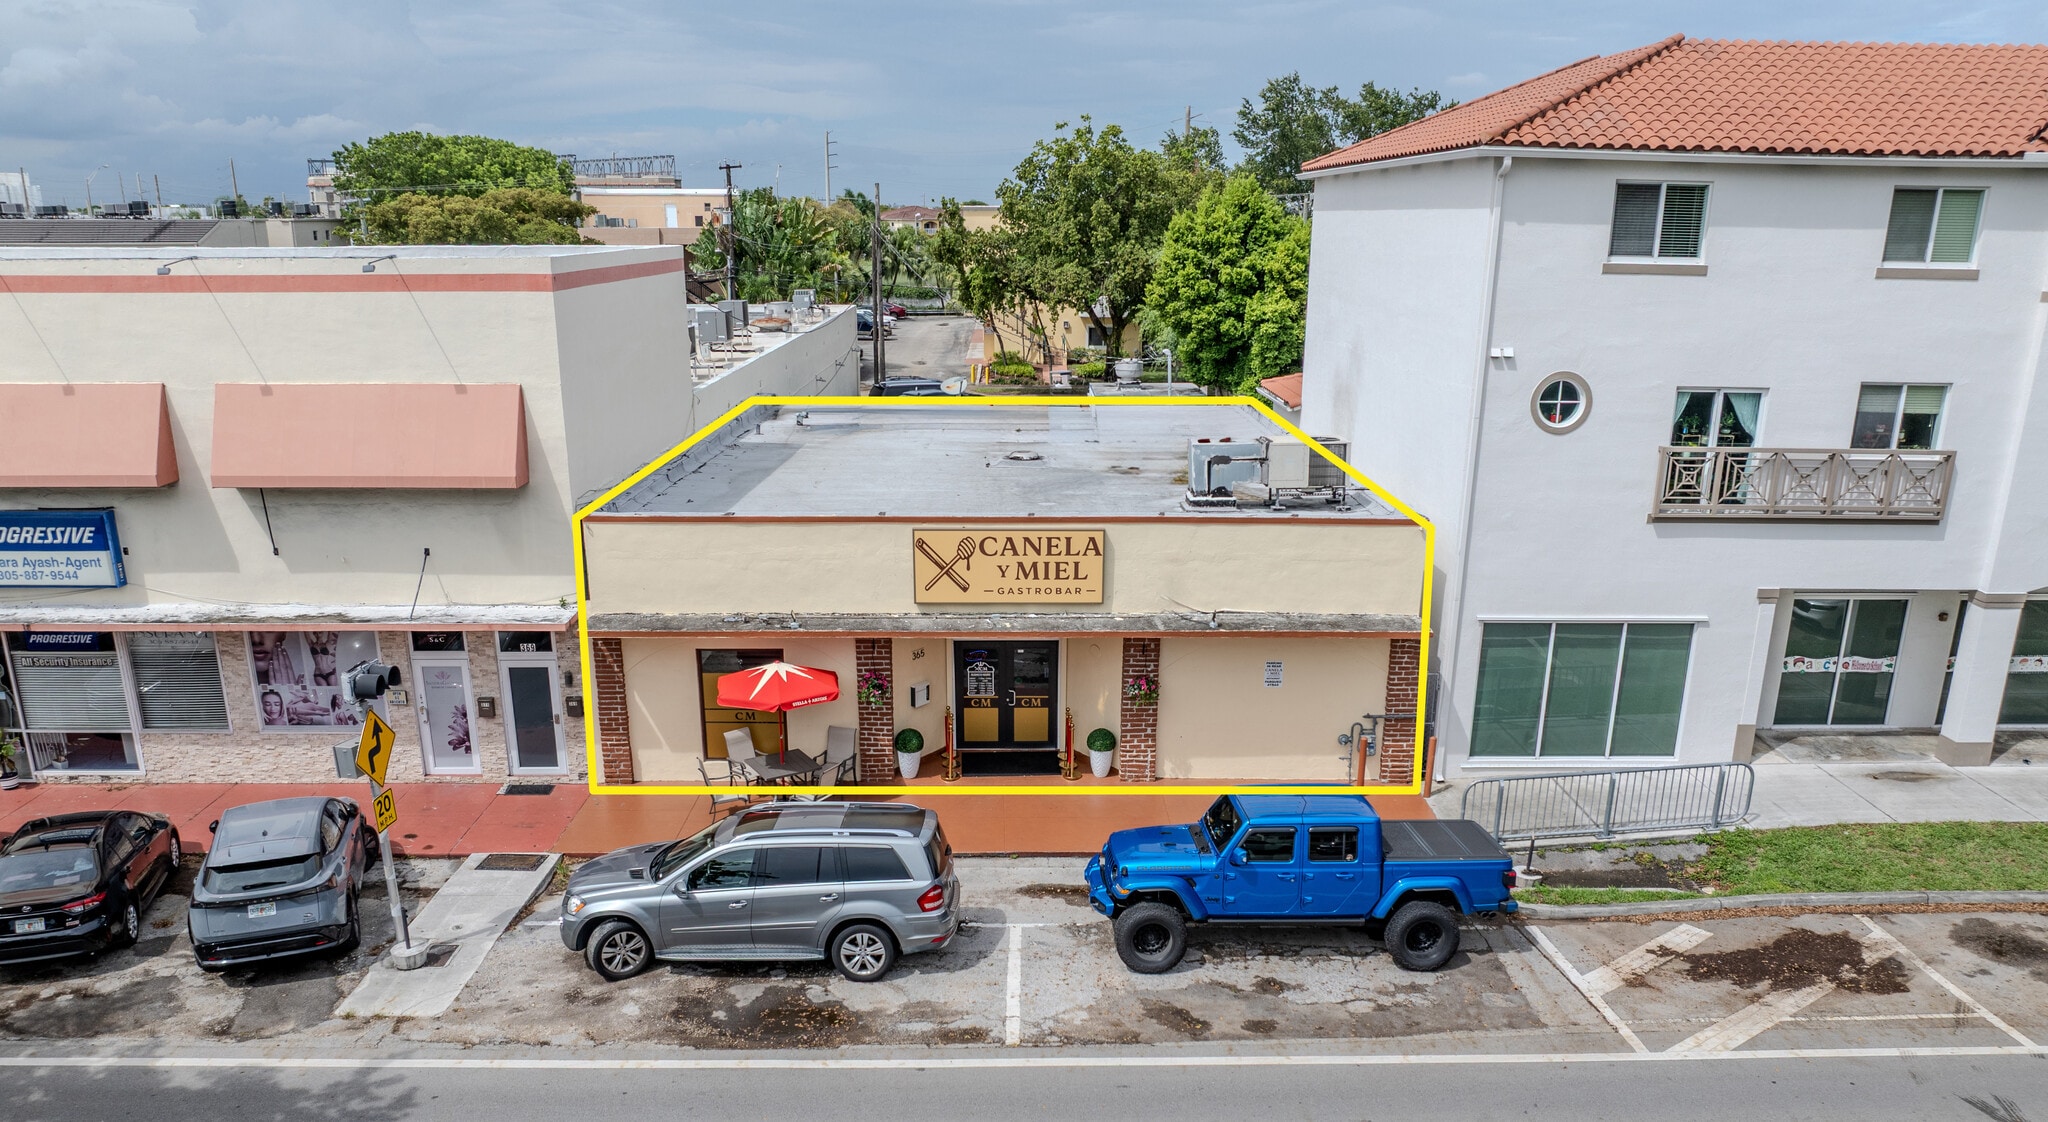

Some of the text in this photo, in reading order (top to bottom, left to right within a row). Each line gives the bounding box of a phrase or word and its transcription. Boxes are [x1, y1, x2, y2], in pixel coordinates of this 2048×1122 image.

[978, 536, 1102, 557] CANELA
[22, 556, 102, 571] Ayash-Agent
[0, 570, 79, 580] 305-887-9544
[996, 561, 1088, 580] Y MIEL
[997, 587, 1083, 595] GASTROBAR
[29, 634, 93, 644] PROGRESSIVE
[520, 643, 535, 652] 369
[912, 649, 926, 661] 365
[21, 656, 113, 668] All Security Insurance
[971, 698, 991, 707] CM
[1021, 698, 1041, 707] CM
[735, 712, 756, 721] CM
[376, 794, 391, 818] 20
